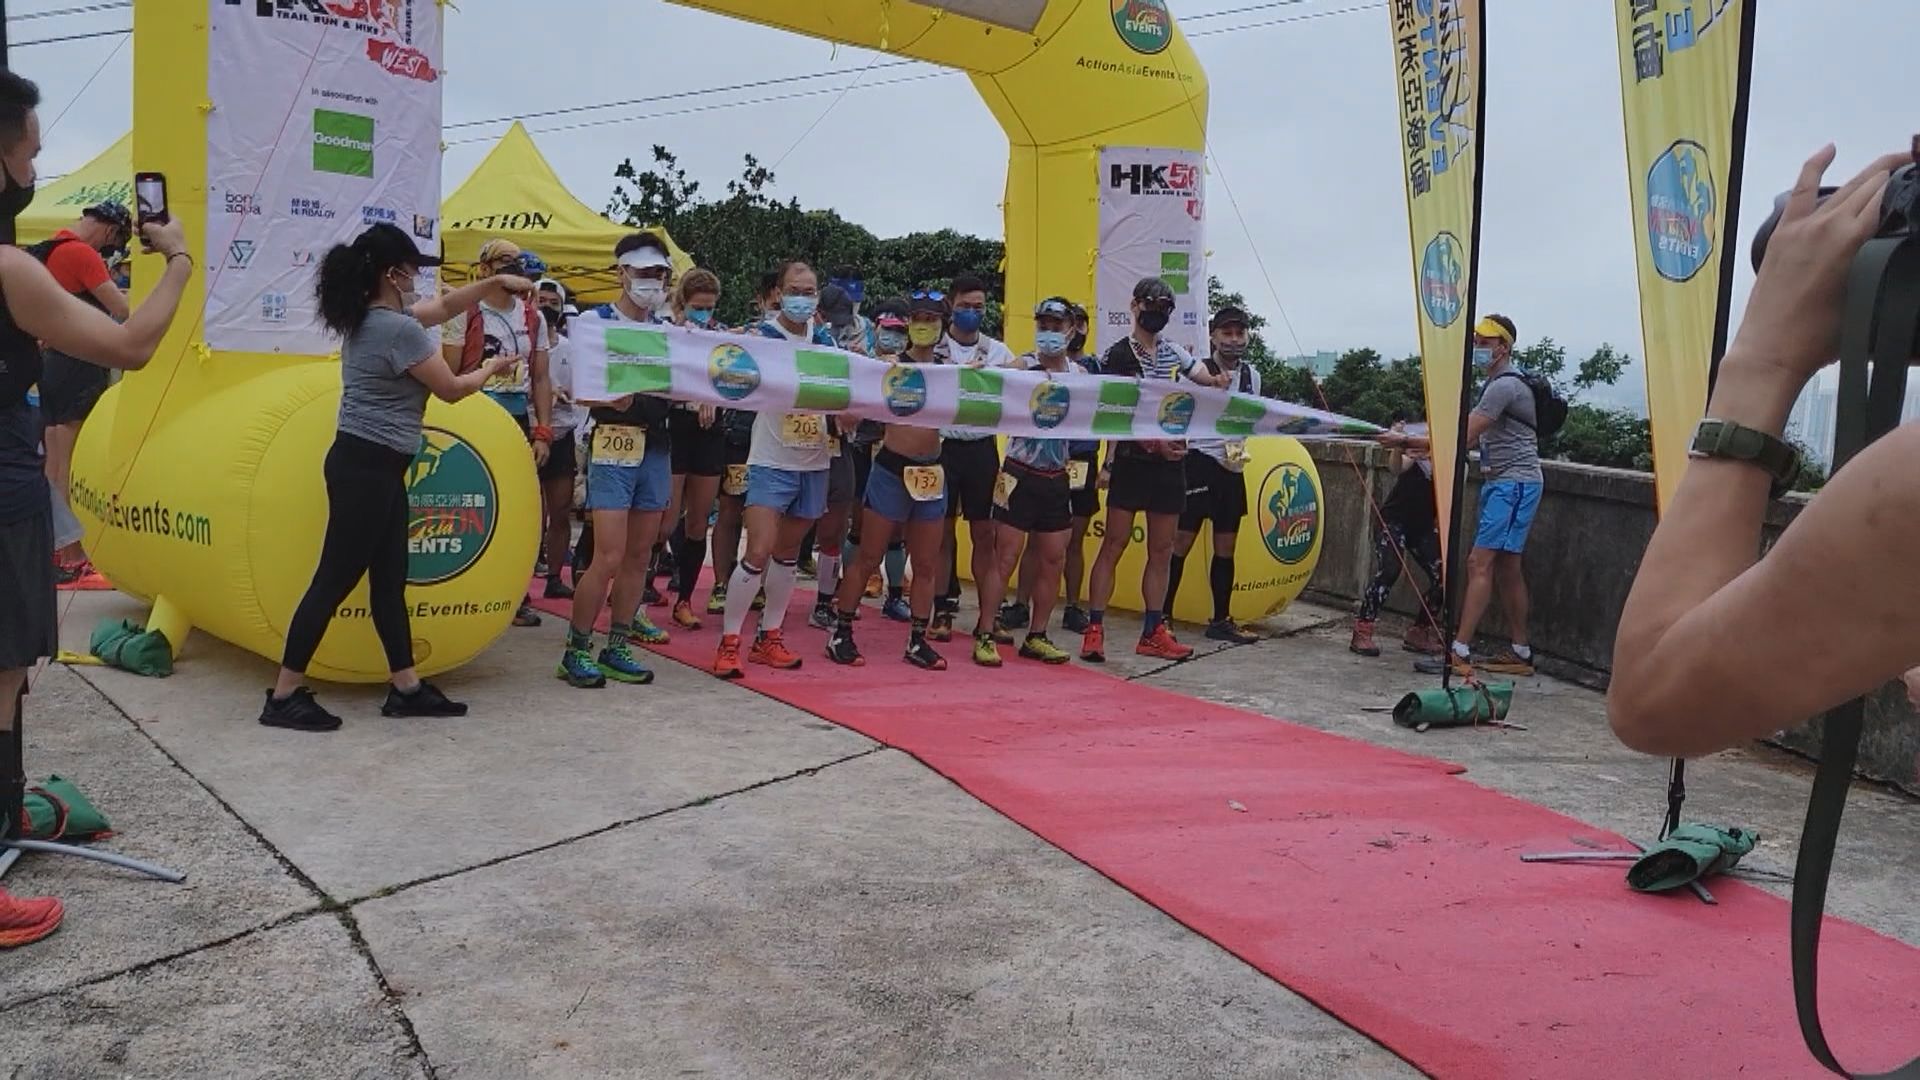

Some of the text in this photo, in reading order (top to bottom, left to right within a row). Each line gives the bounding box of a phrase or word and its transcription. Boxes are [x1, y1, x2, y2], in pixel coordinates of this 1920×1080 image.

[276, 10, 309, 21] TRAIL
[313, 15, 338, 27] RUN
[342, 20, 351, 29] &
[1125, 20, 1162, 36] EVENTS
[382, 47, 428, 78] WEST
[793, 420, 818, 435] 203
[913, 475, 938, 489] 132
[407, 538, 462, 554] ENTS
[1276, 531, 1311, 548] EVENTS
